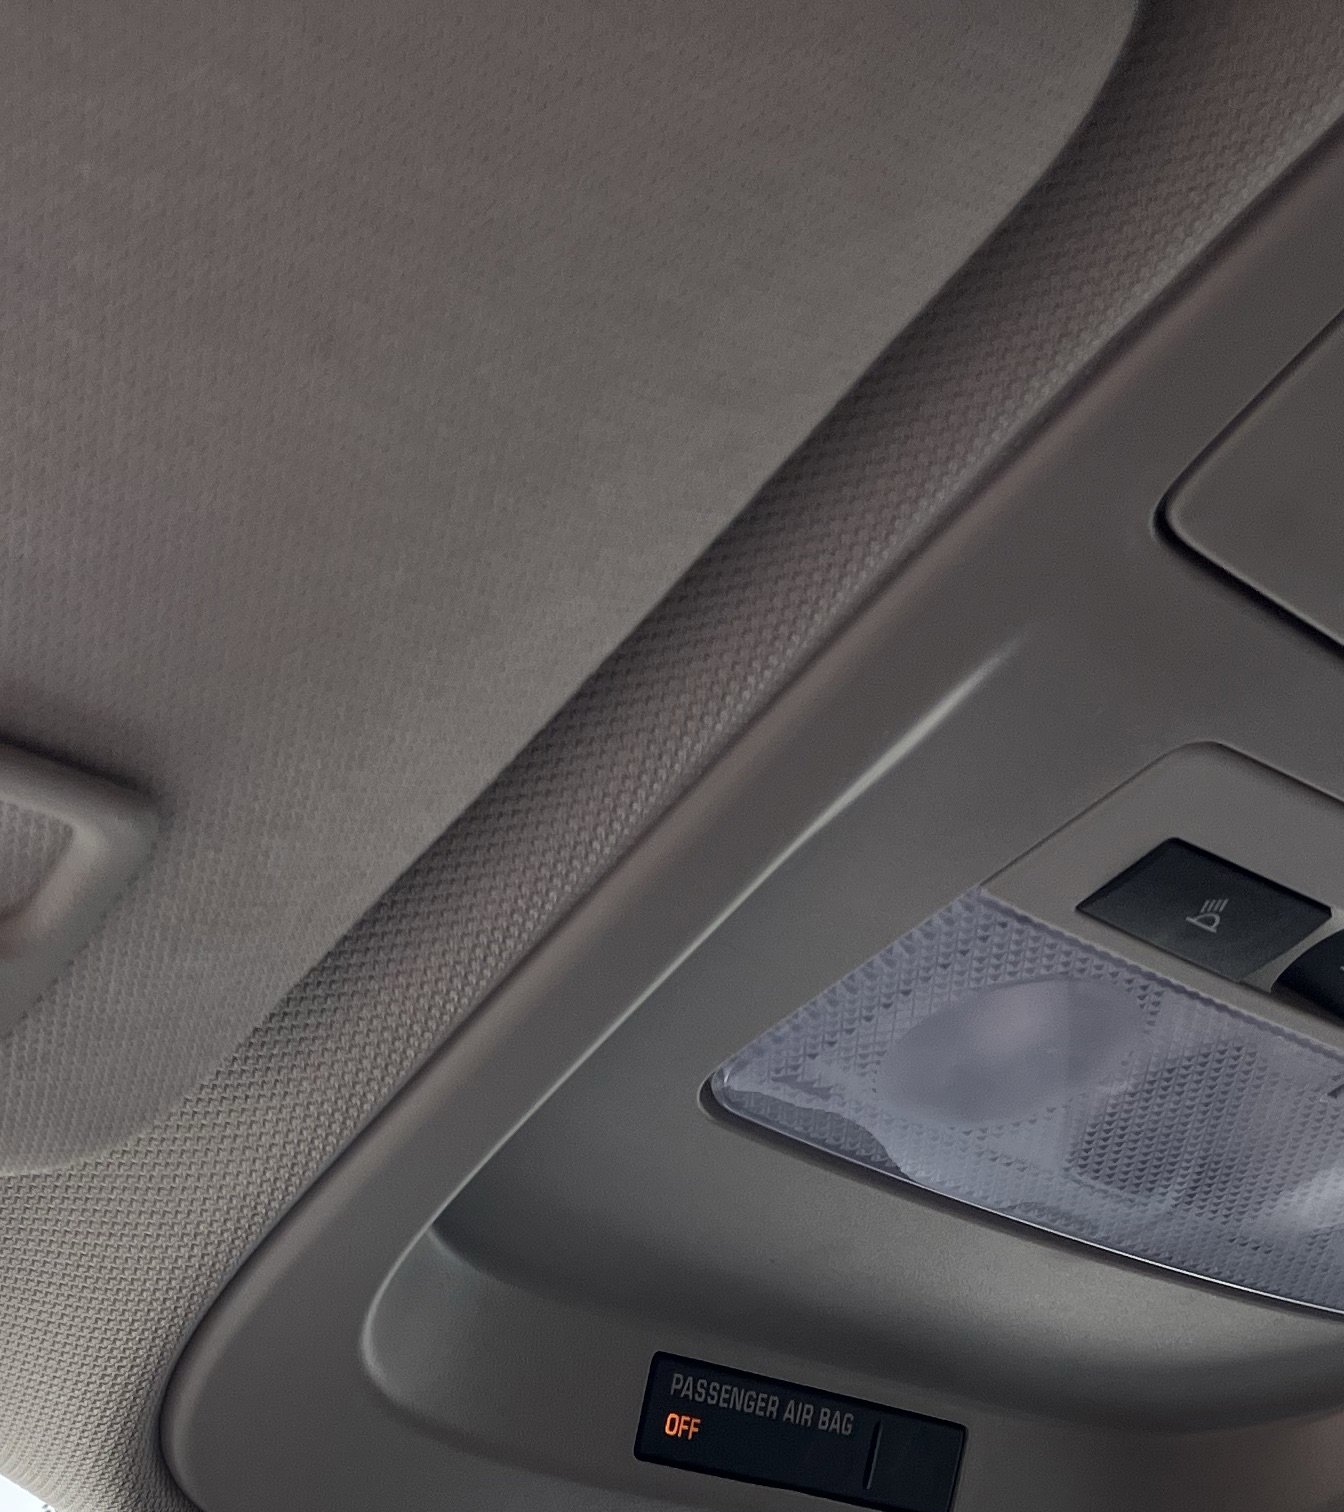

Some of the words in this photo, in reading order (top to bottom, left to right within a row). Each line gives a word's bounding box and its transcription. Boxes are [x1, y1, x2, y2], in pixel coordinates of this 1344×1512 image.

[664, 1413, 701, 1440] OFF
[670, 1373, 780, 1420] PASSENGER
[783, 1399, 815, 1427] AIR
[818, 1407, 854, 1436] BAG
